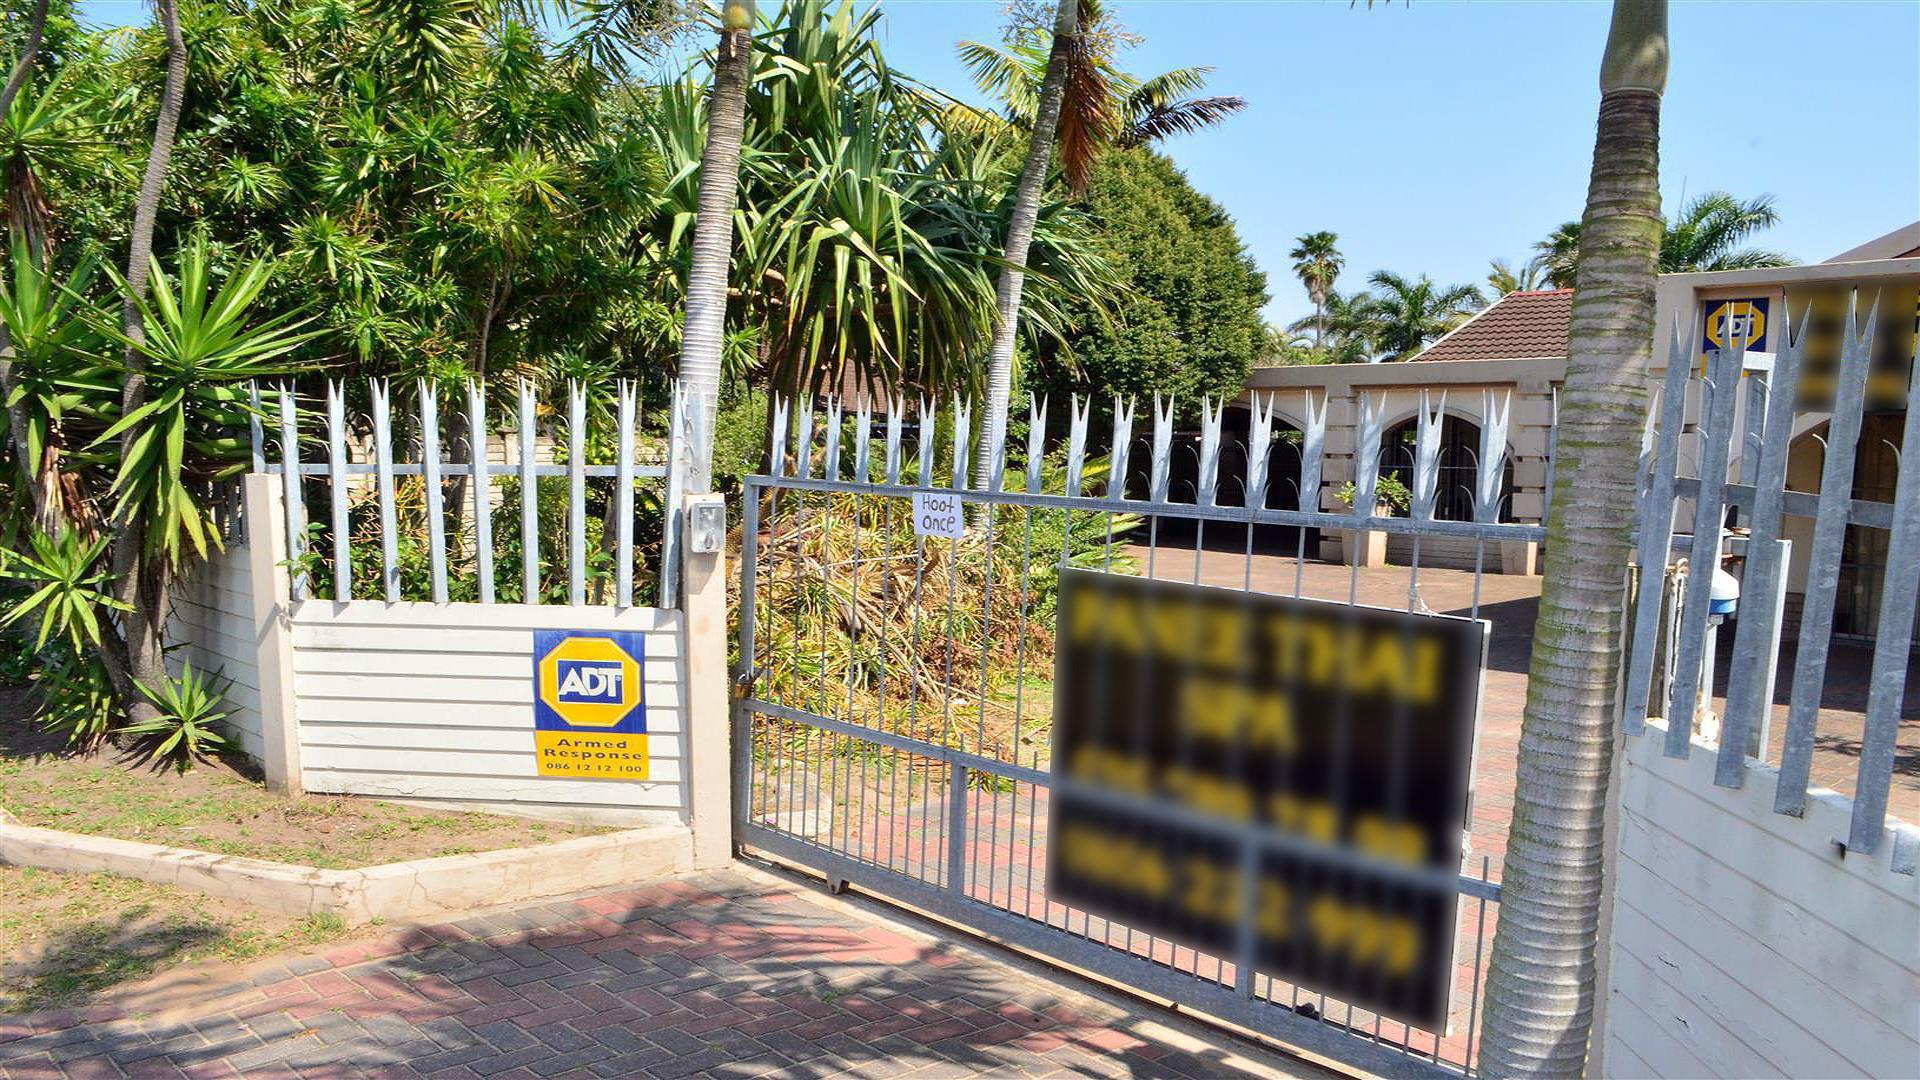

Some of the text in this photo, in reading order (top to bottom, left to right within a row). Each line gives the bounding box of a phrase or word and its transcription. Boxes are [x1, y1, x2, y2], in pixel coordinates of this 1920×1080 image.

[922, 494, 955, 514] Hoot
[558, 667, 622, 698] ADT
[557, 738, 628, 750] Armed
[543, 748, 643, 761] Response
[546, 762, 570, 771] 086
[577, 763, 591, 771] 12
[619, 765, 642, 773] 100
